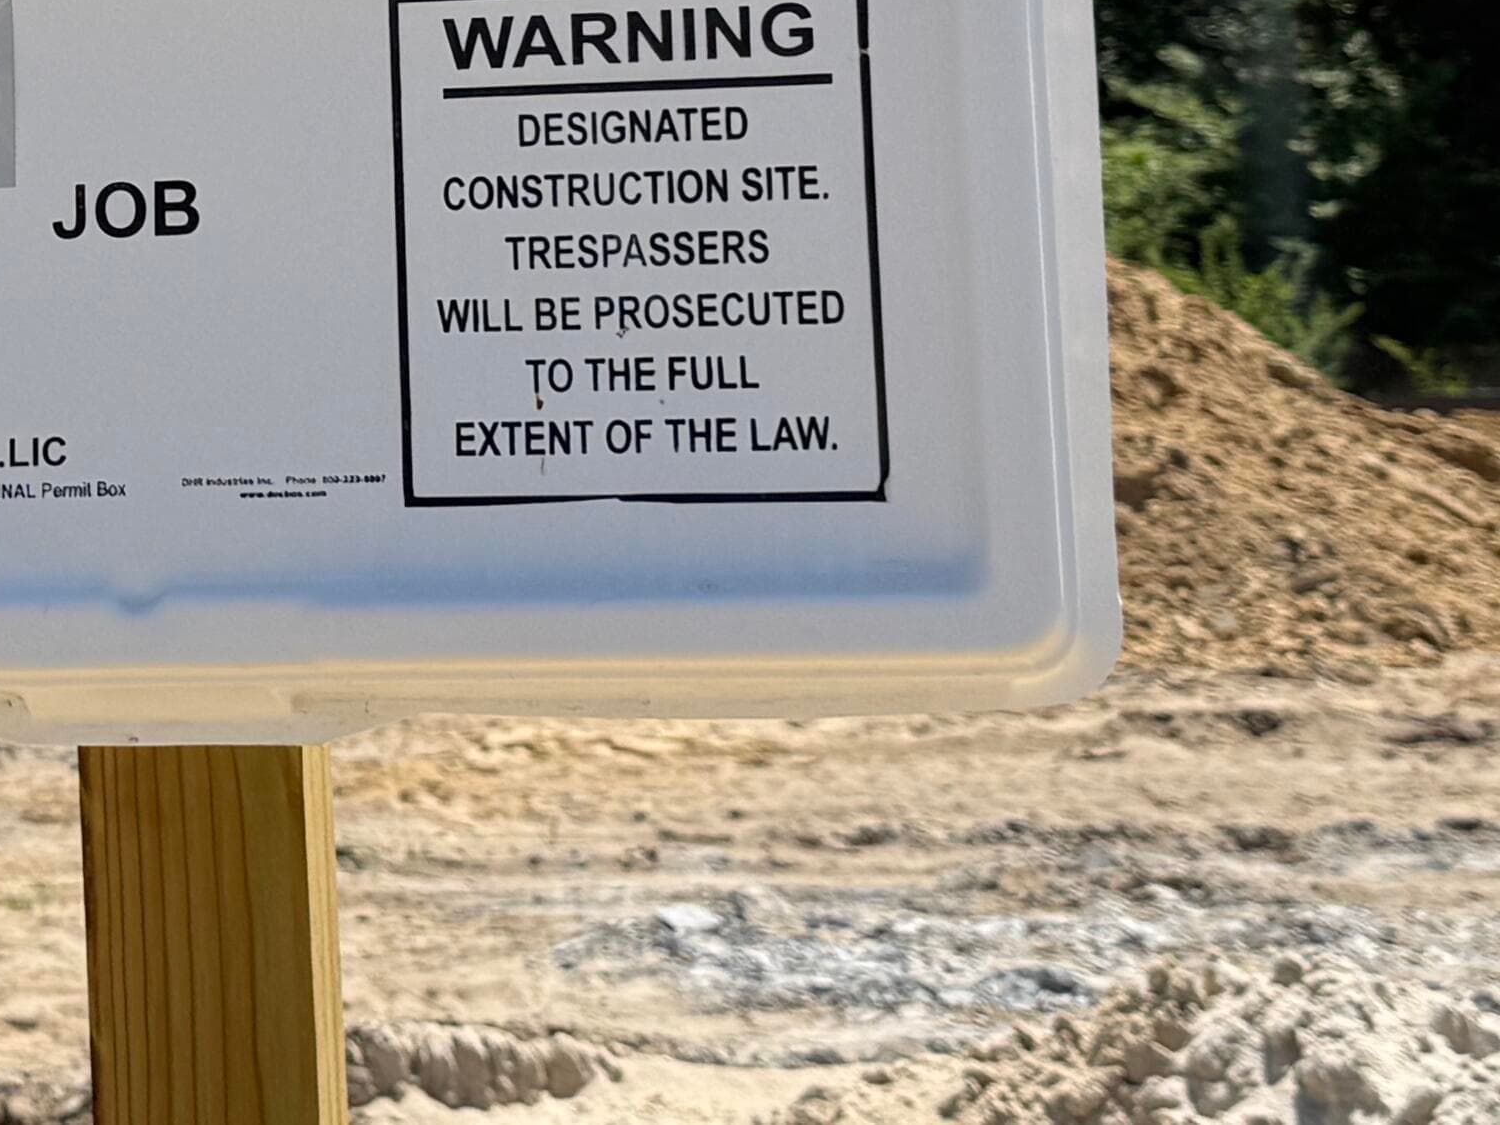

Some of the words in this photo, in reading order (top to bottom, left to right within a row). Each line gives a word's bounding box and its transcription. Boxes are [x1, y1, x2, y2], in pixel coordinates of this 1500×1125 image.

[442, 2, 815, 71] WARNING
[517, 105, 749, 148] DESIGNATED
[442, 168, 729, 211] CONSTRUCTION
[740, 165, 830, 202] SITE.
[52, 180, 200, 240] JOB
[504, 229, 770, 271] TRESPASSERS
[436, 298, 524, 334] WILL
[533, 296, 582, 332] BE
[593, 290, 846, 331] PROSECUTED
[525, 358, 574, 394] TO
[584, 356, 657, 392] THE
[667, 355, 760, 391] FULL
[454, 419, 594, 457] EXTENT
[605, 419, 653, 455] OF
[664, 417, 738, 453] THE
[749, 415, 839, 452] LAW.
[41, 480, 92, 499] Permit
[96, 480, 127, 498] Box
